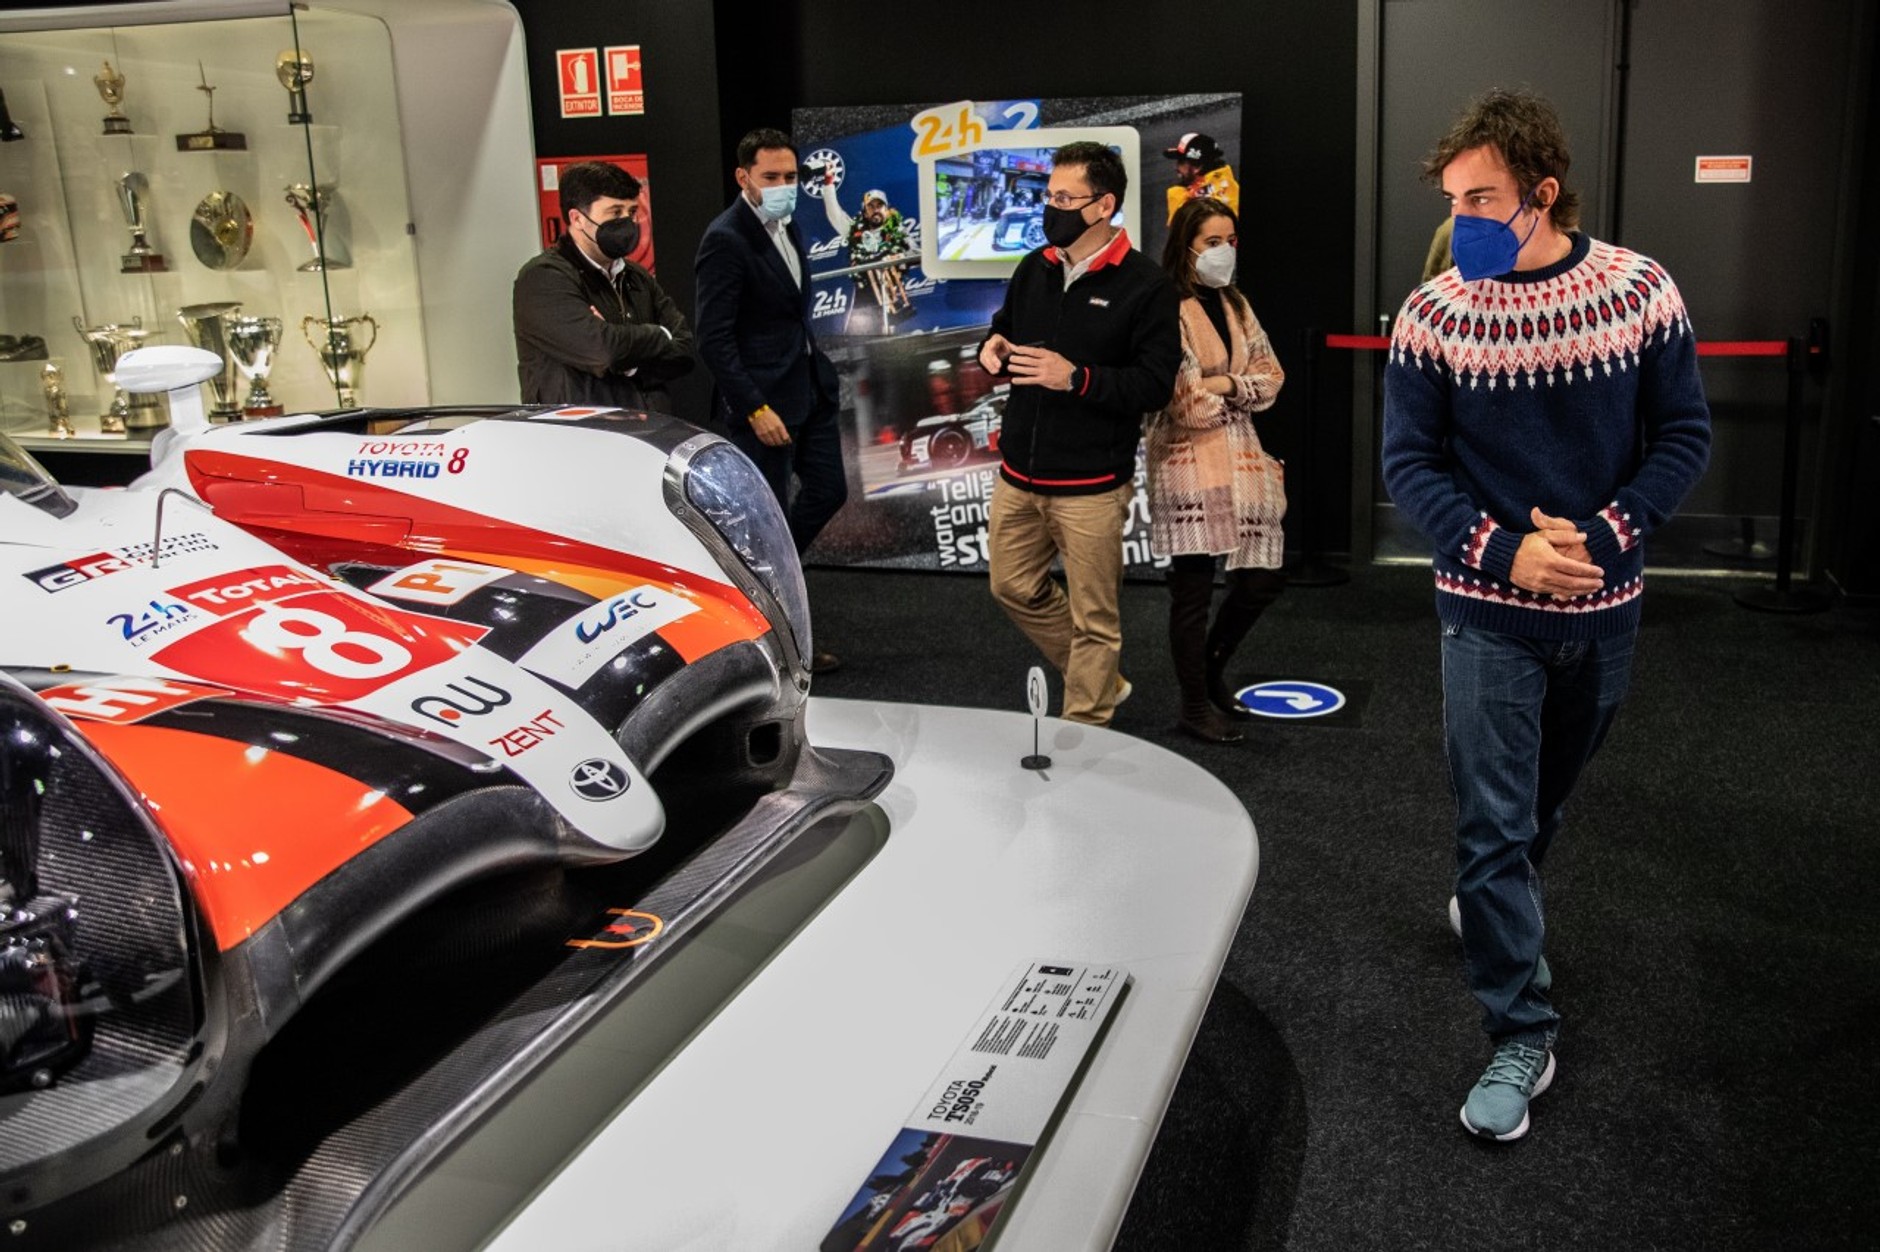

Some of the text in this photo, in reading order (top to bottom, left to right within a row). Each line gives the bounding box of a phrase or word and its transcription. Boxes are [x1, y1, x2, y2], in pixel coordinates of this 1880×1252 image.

[919, 107, 982, 156] 24h
[813, 287, 848, 312] 24h
[359, 441, 445, 457] TOYOTA
[447, 447, 470, 475] 8
[347, 459, 441, 479] HYBRID
[32, 555, 131, 593] GR
[188, 573, 318, 604] TOTAL
[391, 563, 491, 595] P1
[106, 600, 189, 641] 24h
[575, 592, 657, 644] WEC
[247, 607, 413, 680] 8
[488, 709, 565, 757] ZENT
[926, 1080, 967, 1121] TOYOTA
[944, 1080, 985, 1122] TS050
